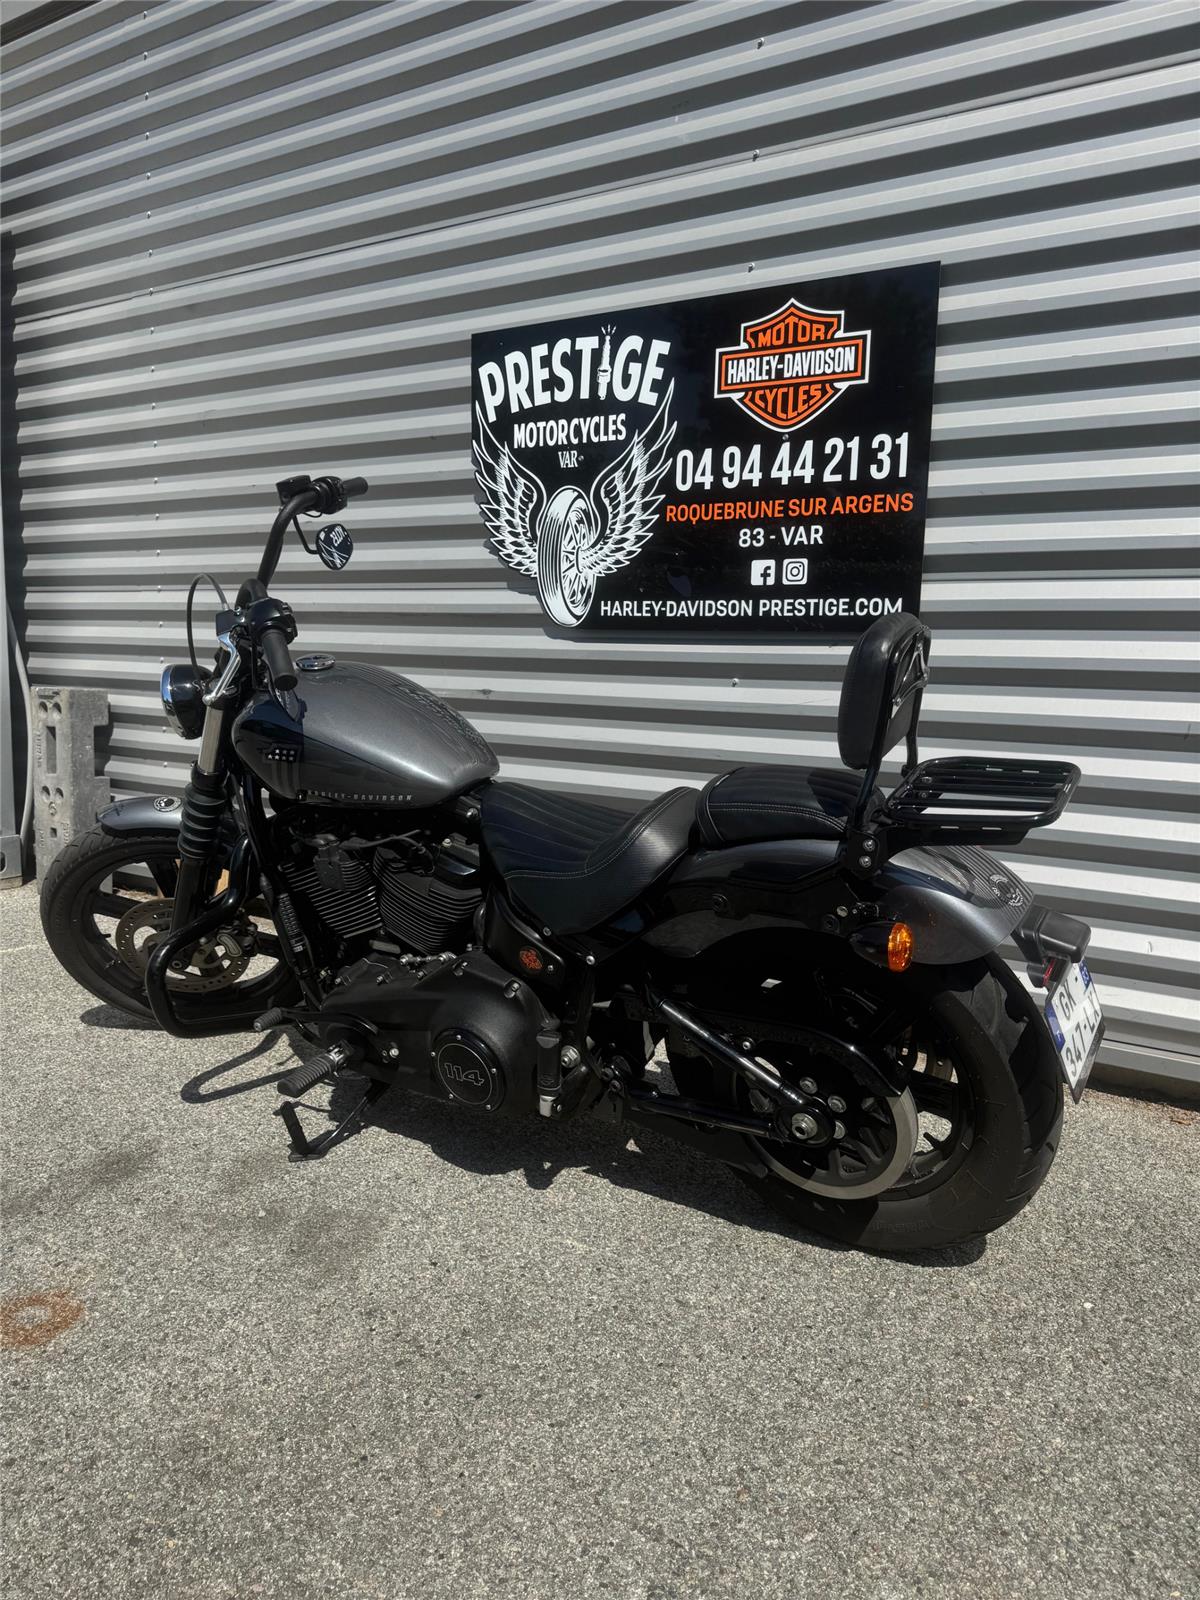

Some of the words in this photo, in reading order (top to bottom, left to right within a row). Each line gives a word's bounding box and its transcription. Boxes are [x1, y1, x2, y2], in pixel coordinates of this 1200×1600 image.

[757, 314, 826, 348] MOTOR
[478, 335, 672, 424] PRESTIGE
[727, 345, 856, 385] HARLEY-DAVIDSON
[754, 383, 823, 420] CYCLES
[513, 413, 627, 449] MOTORCYCLES
[557, 451, 578, 469] VAR
[675, 448, 714, 492] 04
[721, 444, 763, 489] 94
[770, 439, 815, 486] 44
[822, 434, 860, 483] 21
[869, 431, 910, 479] 31
[665, 499, 785, 525] ROQUEBRUNE
[788, 496, 827, 518] SUR
[830, 492, 914, 516] ARGENS
[738, 528, 765, 548] 83
[781, 525, 824, 547] VAR
[600, 600, 753, 617] HARLEY-DAVIDSON
[758, 597, 903, 617] PRESTIGE.COM
[443, 1062, 485, 1086] 114
